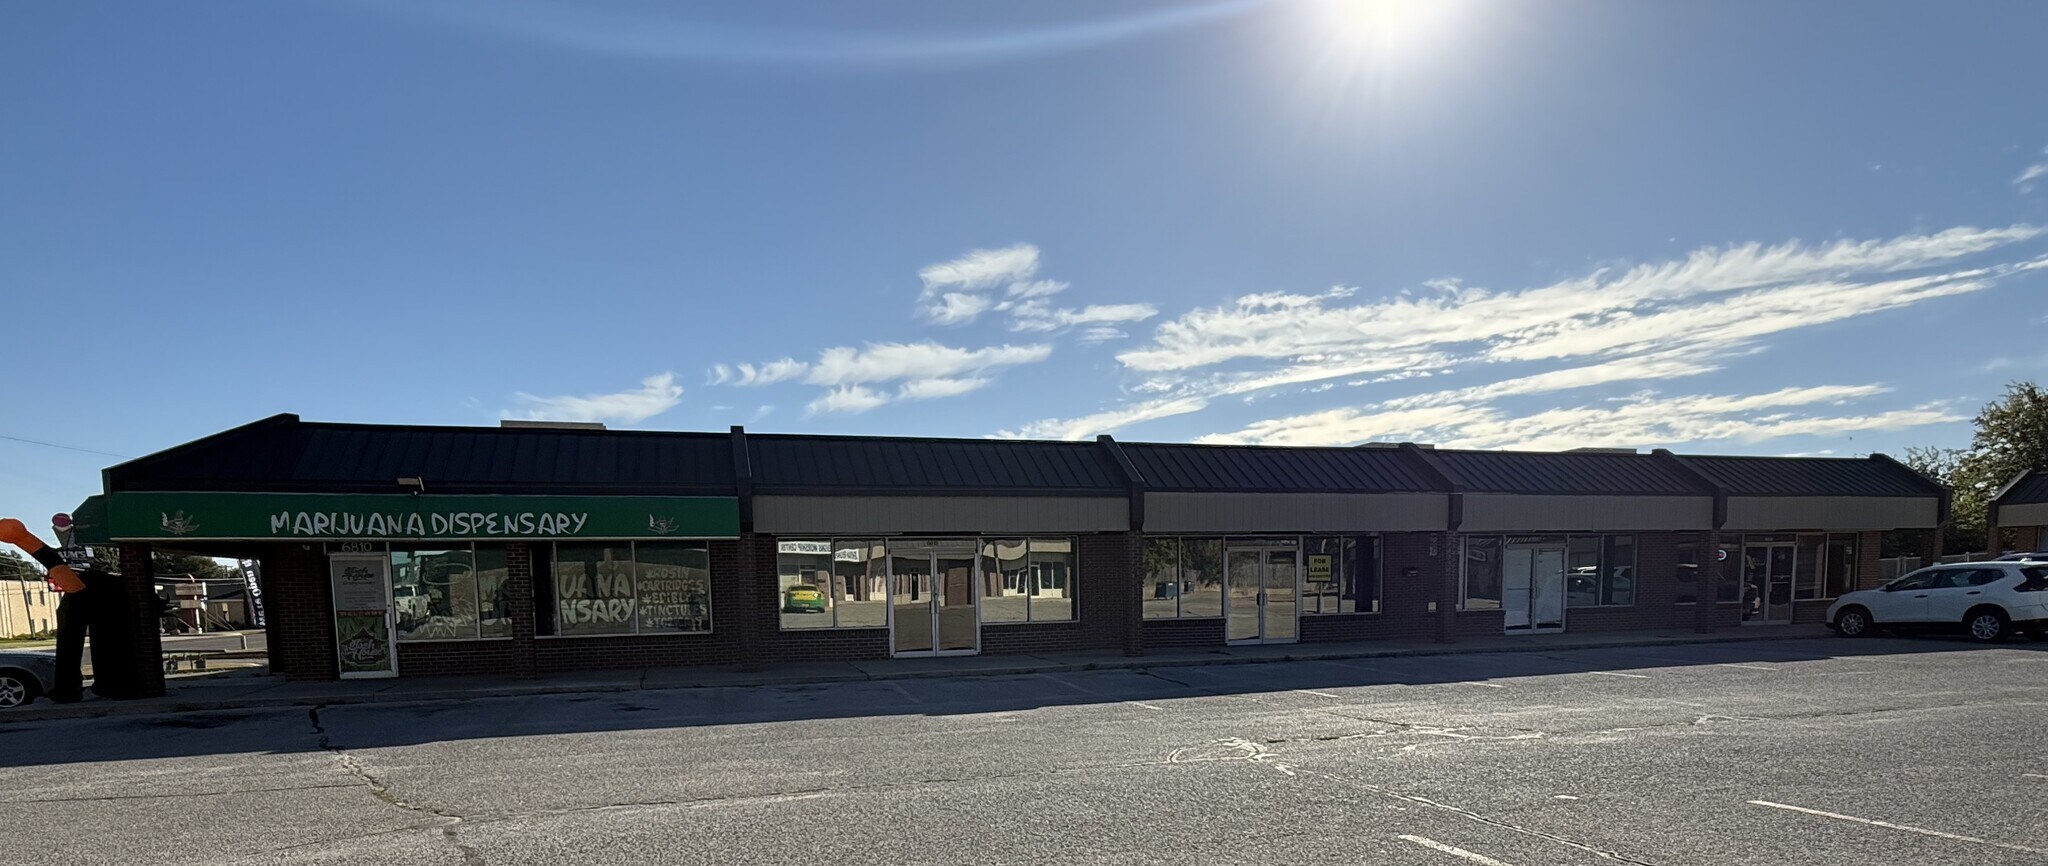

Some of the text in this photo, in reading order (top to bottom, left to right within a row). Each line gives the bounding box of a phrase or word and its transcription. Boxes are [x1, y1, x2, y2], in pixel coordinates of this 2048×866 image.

[270, 511, 588, 536] MARIJUANA DISPENSARY
[341, 542, 373, 553] 6810
[653, 567, 690, 579] ROSIN
[561, 598, 635, 624] NSARY
